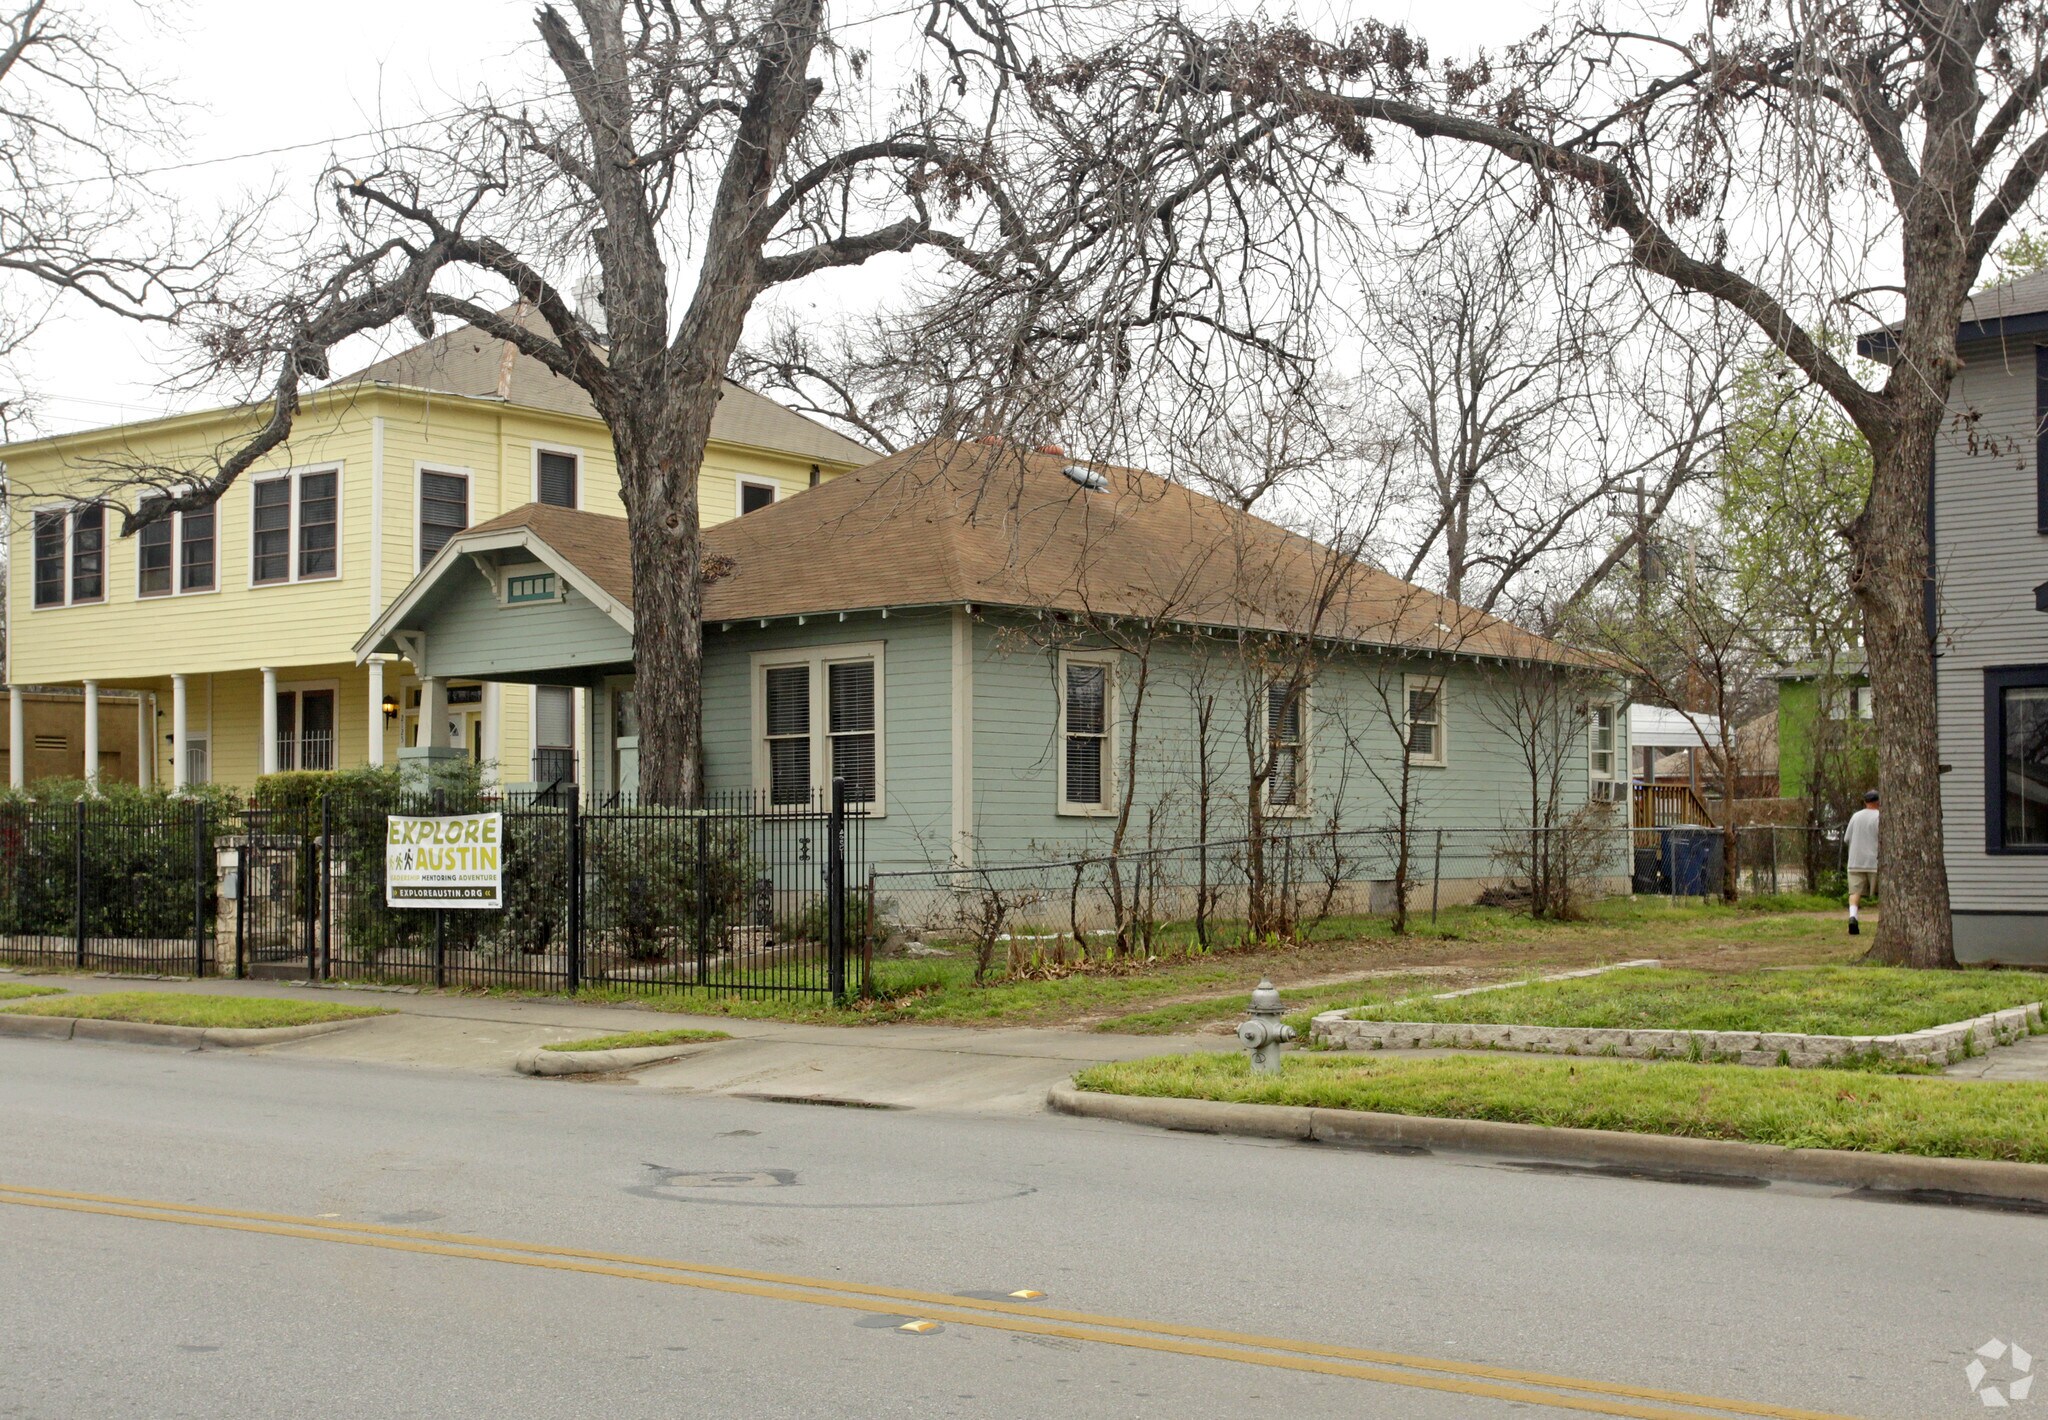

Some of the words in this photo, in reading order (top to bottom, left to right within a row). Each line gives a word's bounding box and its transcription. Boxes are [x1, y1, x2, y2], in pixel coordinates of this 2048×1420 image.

[389, 818, 496, 844] EXPLORE
[415, 847, 497, 871] AUSTIN
[390, 874, 420, 882] EADERSHIP
[421, 874, 457, 882] MENTORING
[458, 874, 497, 882] ADVENTURE
[399, 889, 483, 898] EXPLOREAUSTIN.ORG
